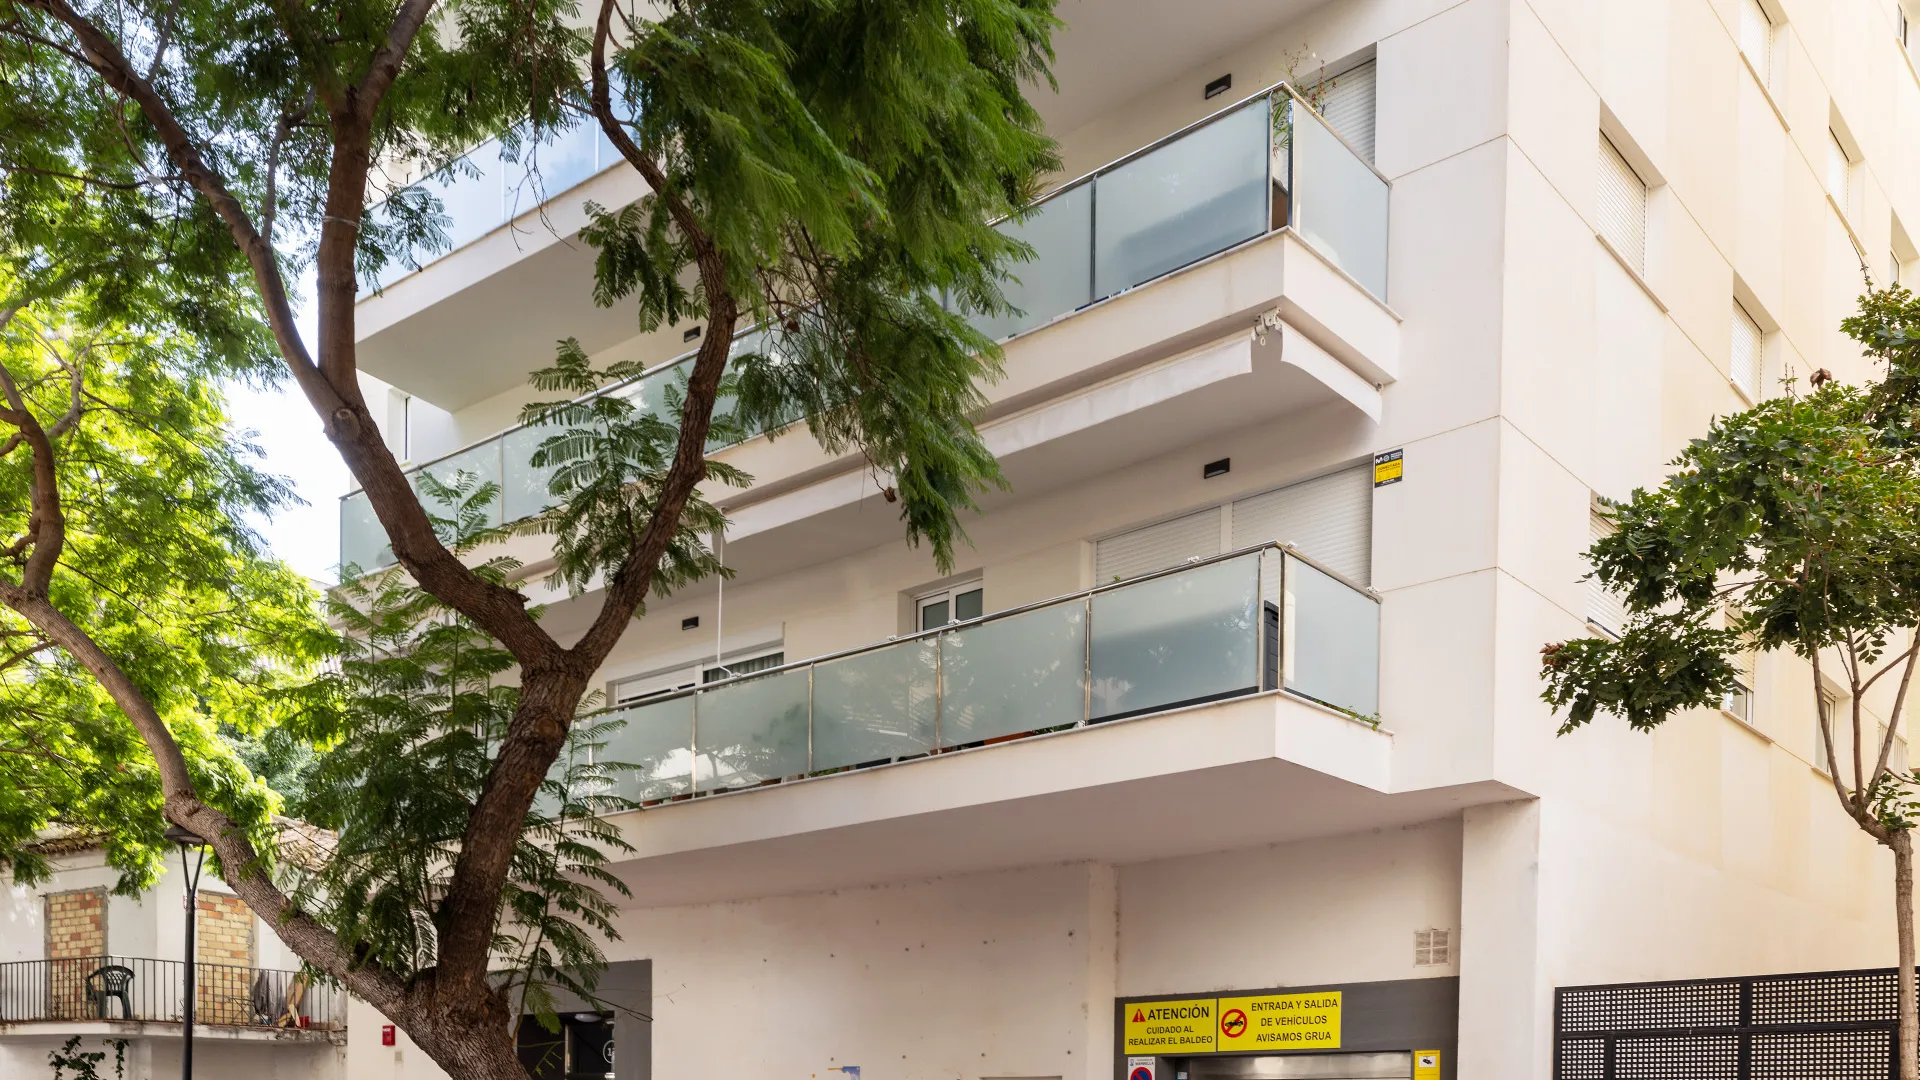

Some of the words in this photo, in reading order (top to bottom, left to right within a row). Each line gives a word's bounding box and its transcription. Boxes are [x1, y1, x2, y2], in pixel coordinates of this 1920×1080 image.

[1251, 1001, 1294, 1011] ENTRADA
[1296, 1000, 1302, 1009] Y
[1304, 999, 1338, 1009] SALIDA
[1148, 1004, 1209, 1020] ATENCIÓN
[1261, 1017, 1273, 1027] DE
[1275, 1015, 1327, 1025] VEHÍCULOS
[1146, 1025, 1182, 1035] CUIDADO
[1183, 1025, 1194, 1033] AL
[1128, 1037, 1166, 1045] REALIZAR
[1168, 1036, 1178, 1045] EL
[1179, 1035, 1213, 1045] BALDEO
[1256, 1033, 1302, 1042] AVISAMOS
[1304, 1031, 1332, 1041] GRUA
